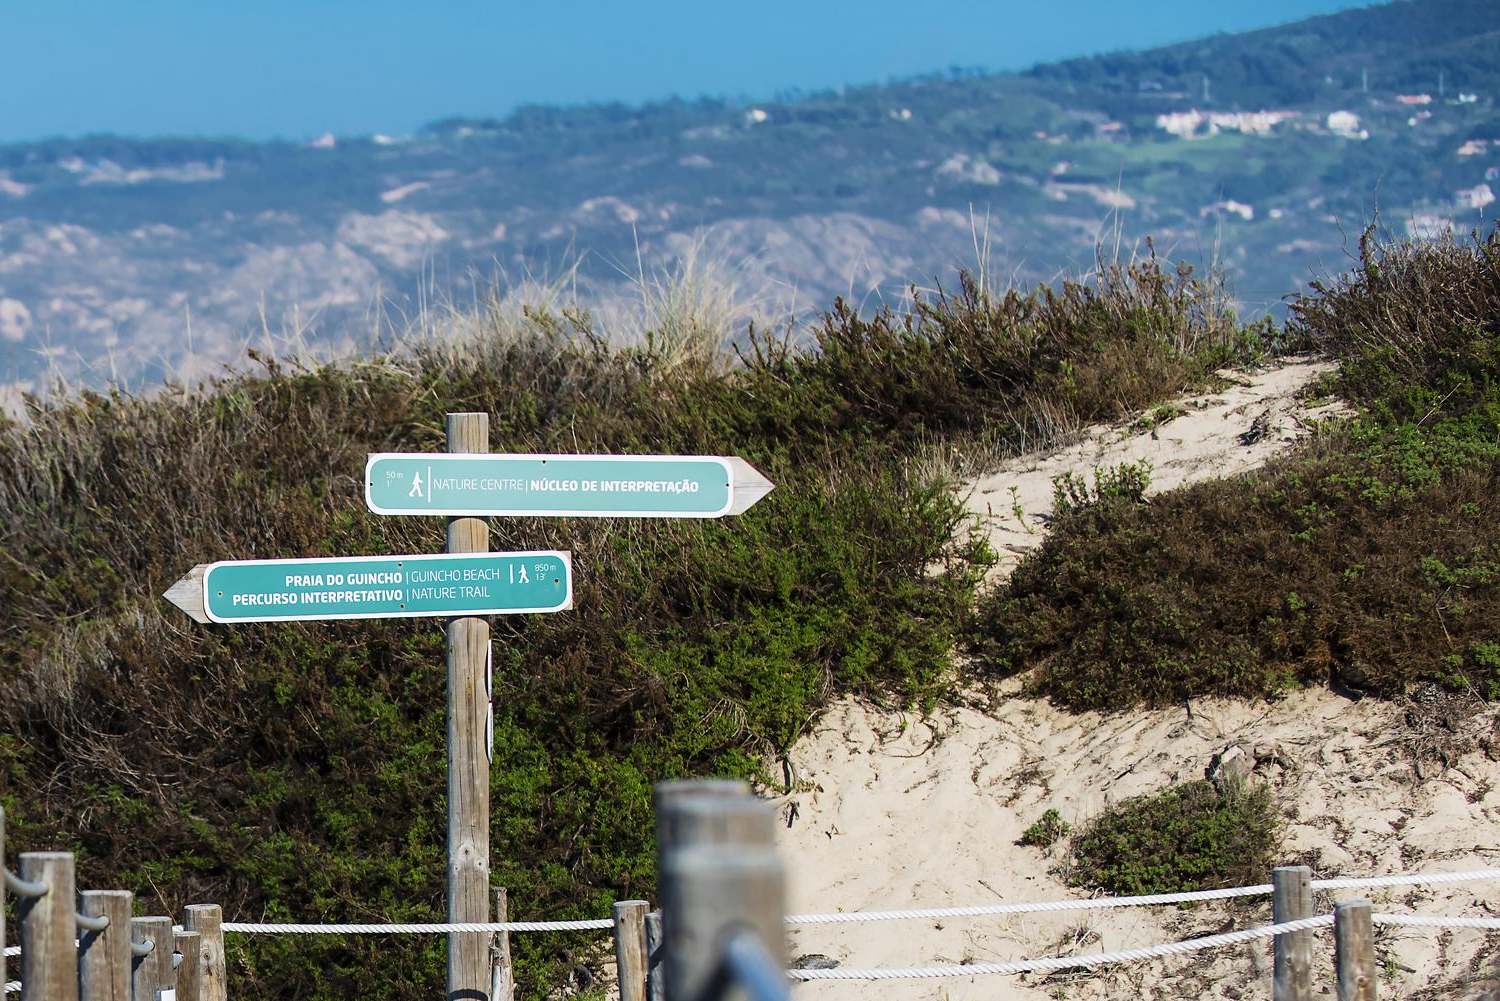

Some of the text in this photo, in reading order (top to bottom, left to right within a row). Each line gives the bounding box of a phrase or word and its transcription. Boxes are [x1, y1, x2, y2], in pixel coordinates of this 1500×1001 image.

[385, 471, 396, 479] 50
[434, 477, 699, 494] NATURE CENTRE NÚCLEO DE INTERPRETAÇÃO
[285, 572, 402, 587] PRAIA DO GUINCHO
[411, 569, 500, 583] GUINCHO BEACH
[233, 589, 402, 606] PERCURSO INTERPRETATIVO
[412, 586, 490, 600] NATURE TRAIL
